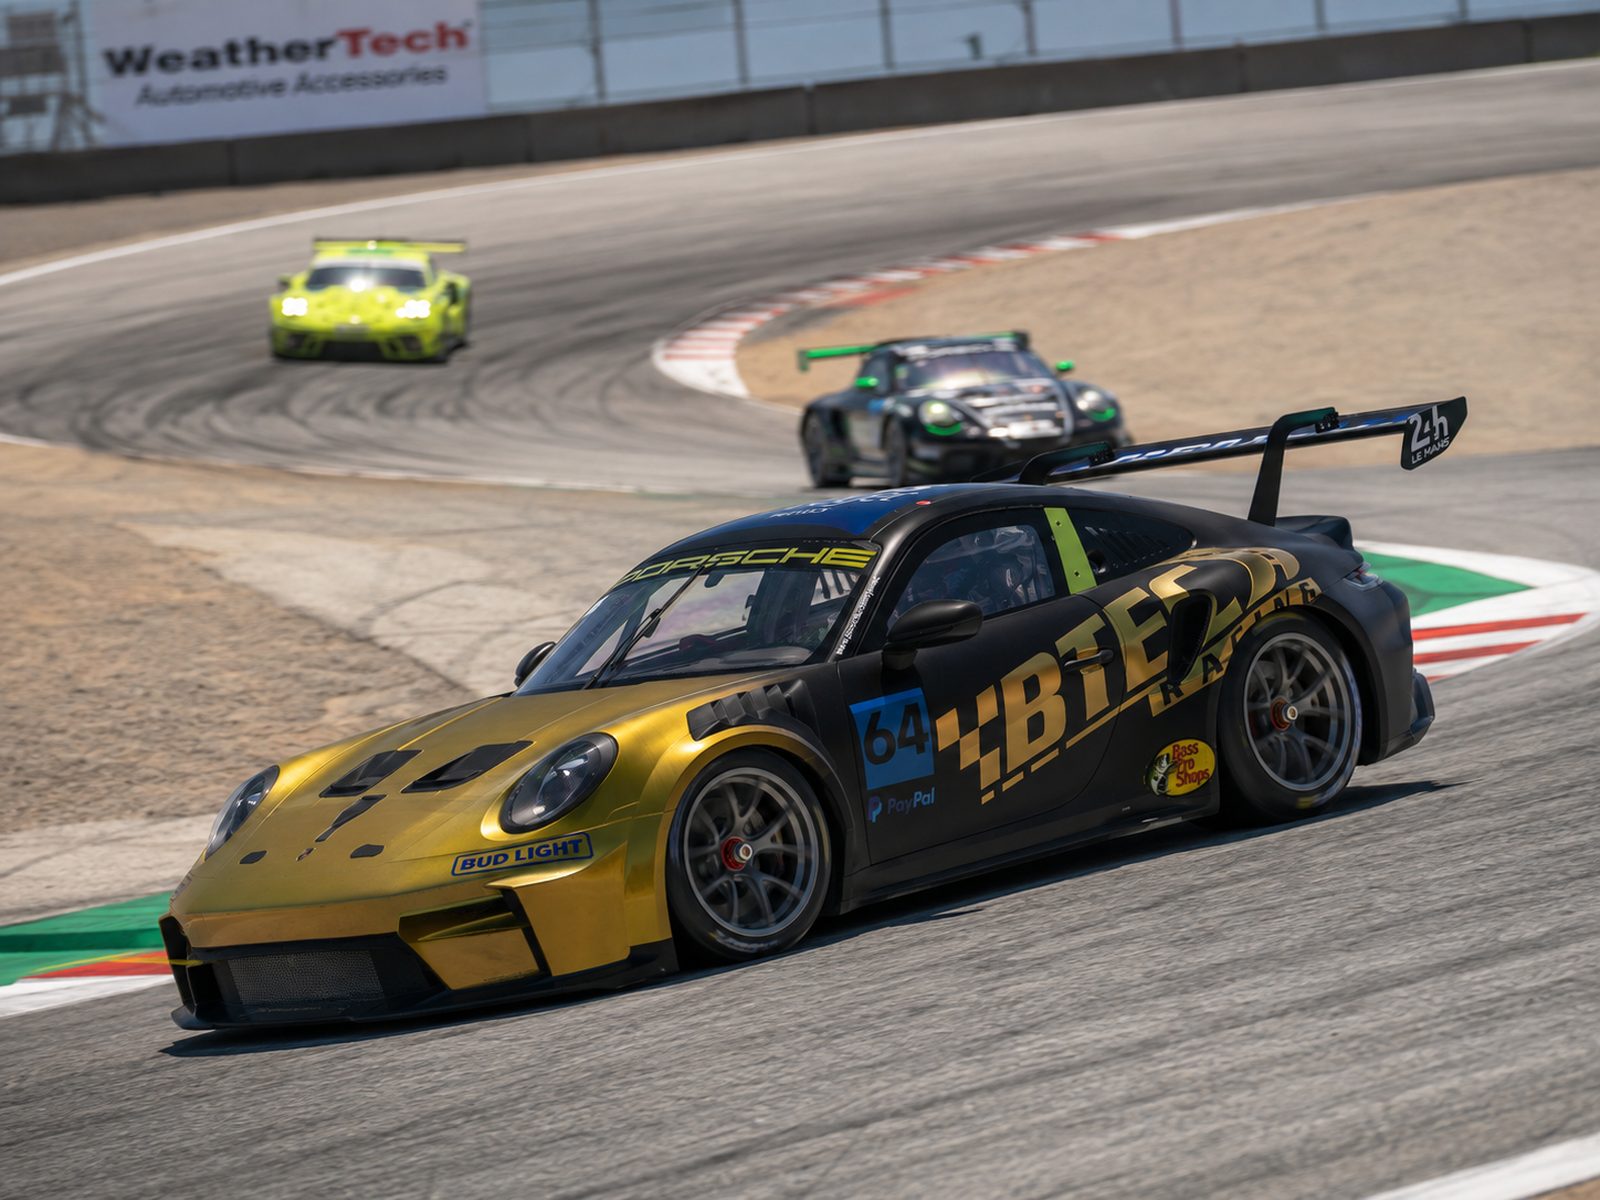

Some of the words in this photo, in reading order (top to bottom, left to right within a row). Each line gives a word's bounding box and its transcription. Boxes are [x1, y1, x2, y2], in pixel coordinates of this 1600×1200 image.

[103, 21, 469, 77] WeatherTech
[136, 79, 288, 107] Automotive
[293, 65, 447, 96] Accessories
[1412, 451, 1423, 464] LE
[1424, 437, 1450, 458] MANS
[612, 547, 878, 588] PORSCHE
[864, 702, 930, 765] 64
[1172, 743, 1199, 760] Bass
[1173, 758, 1195, 774] Pro
[1176, 769, 1210, 787] Shops
[887, 787, 936, 815] PayPal
[460, 853, 509, 871] BUD
[515, 839, 583, 862] LIGHT
